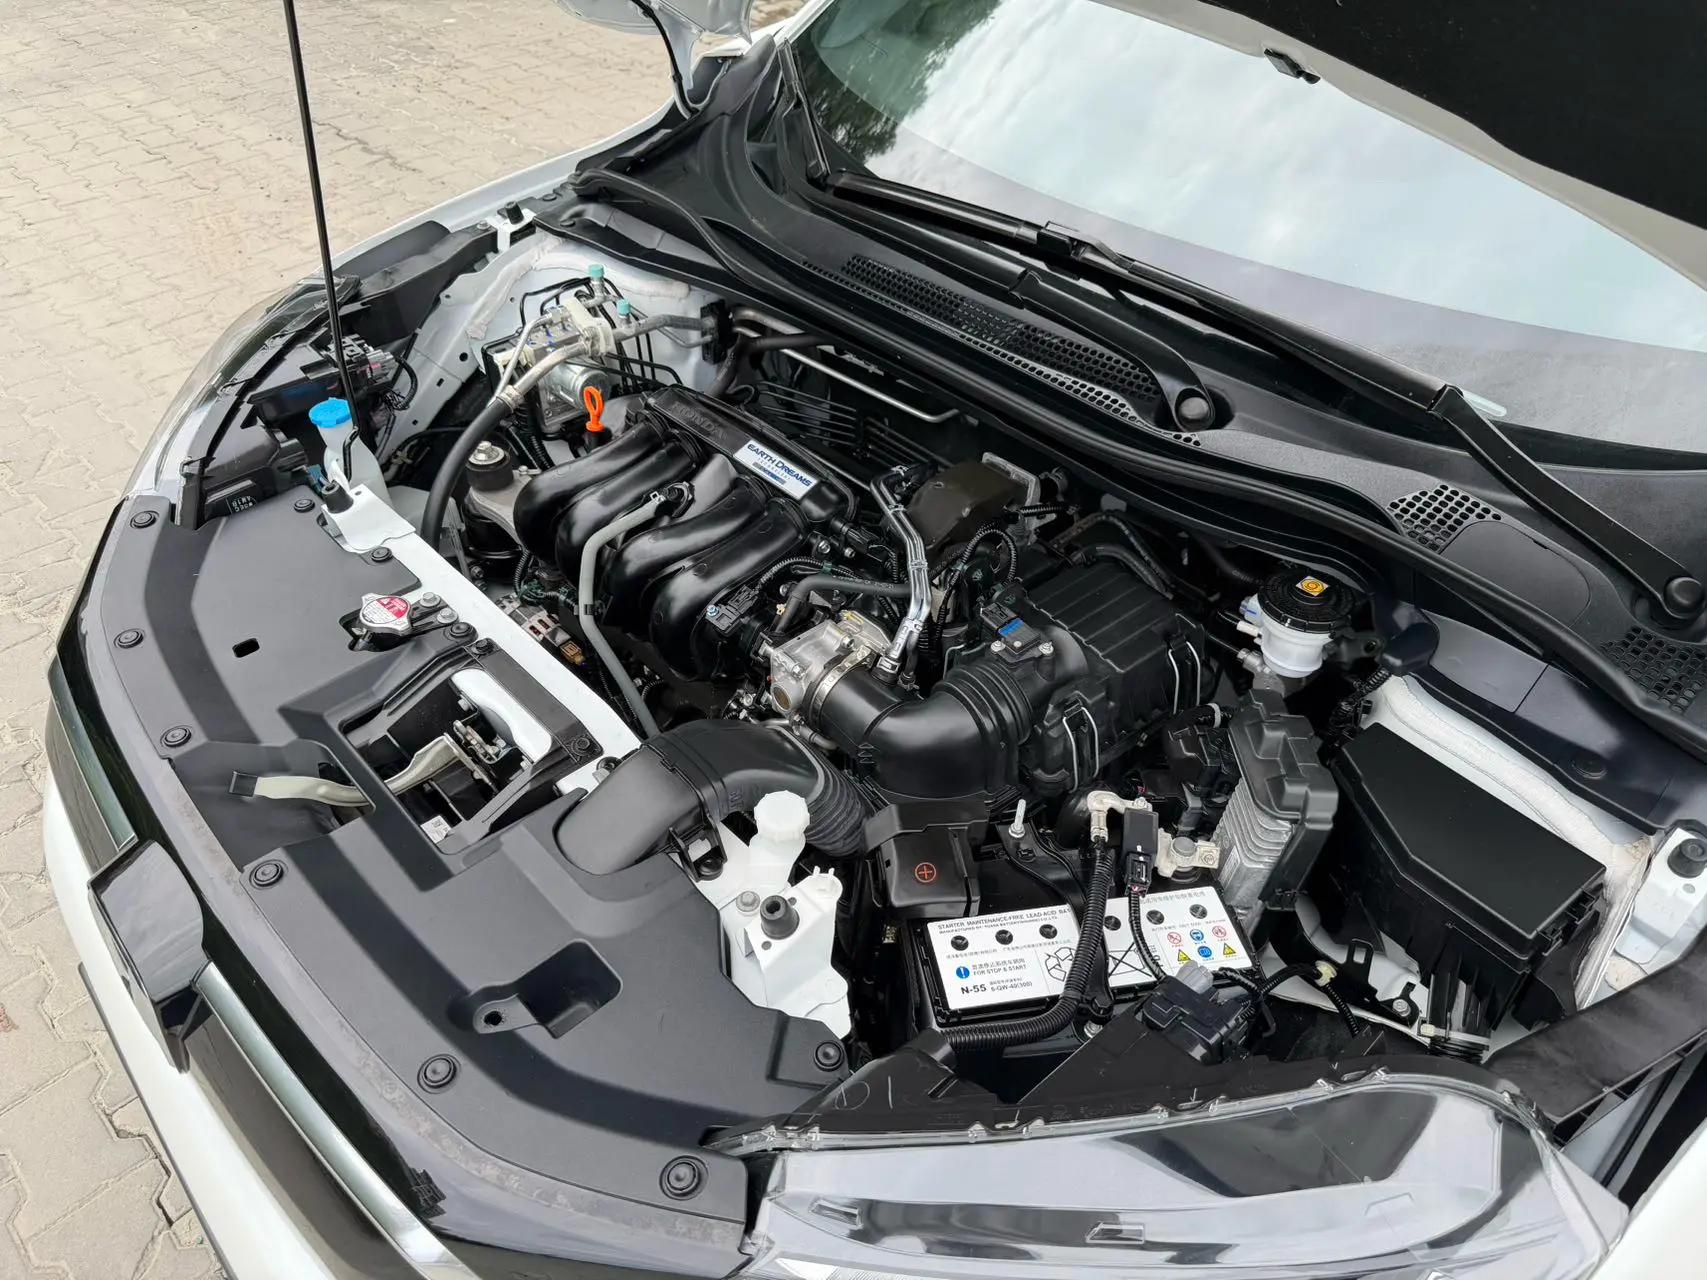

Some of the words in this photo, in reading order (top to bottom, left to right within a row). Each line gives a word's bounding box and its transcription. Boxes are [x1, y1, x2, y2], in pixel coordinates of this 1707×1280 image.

[747, 443, 777, 464] EARTH
[775, 460, 812, 487] DREAMS
[938, 921, 965, 930] STARTER
[960, 983, 987, 995] N-55
